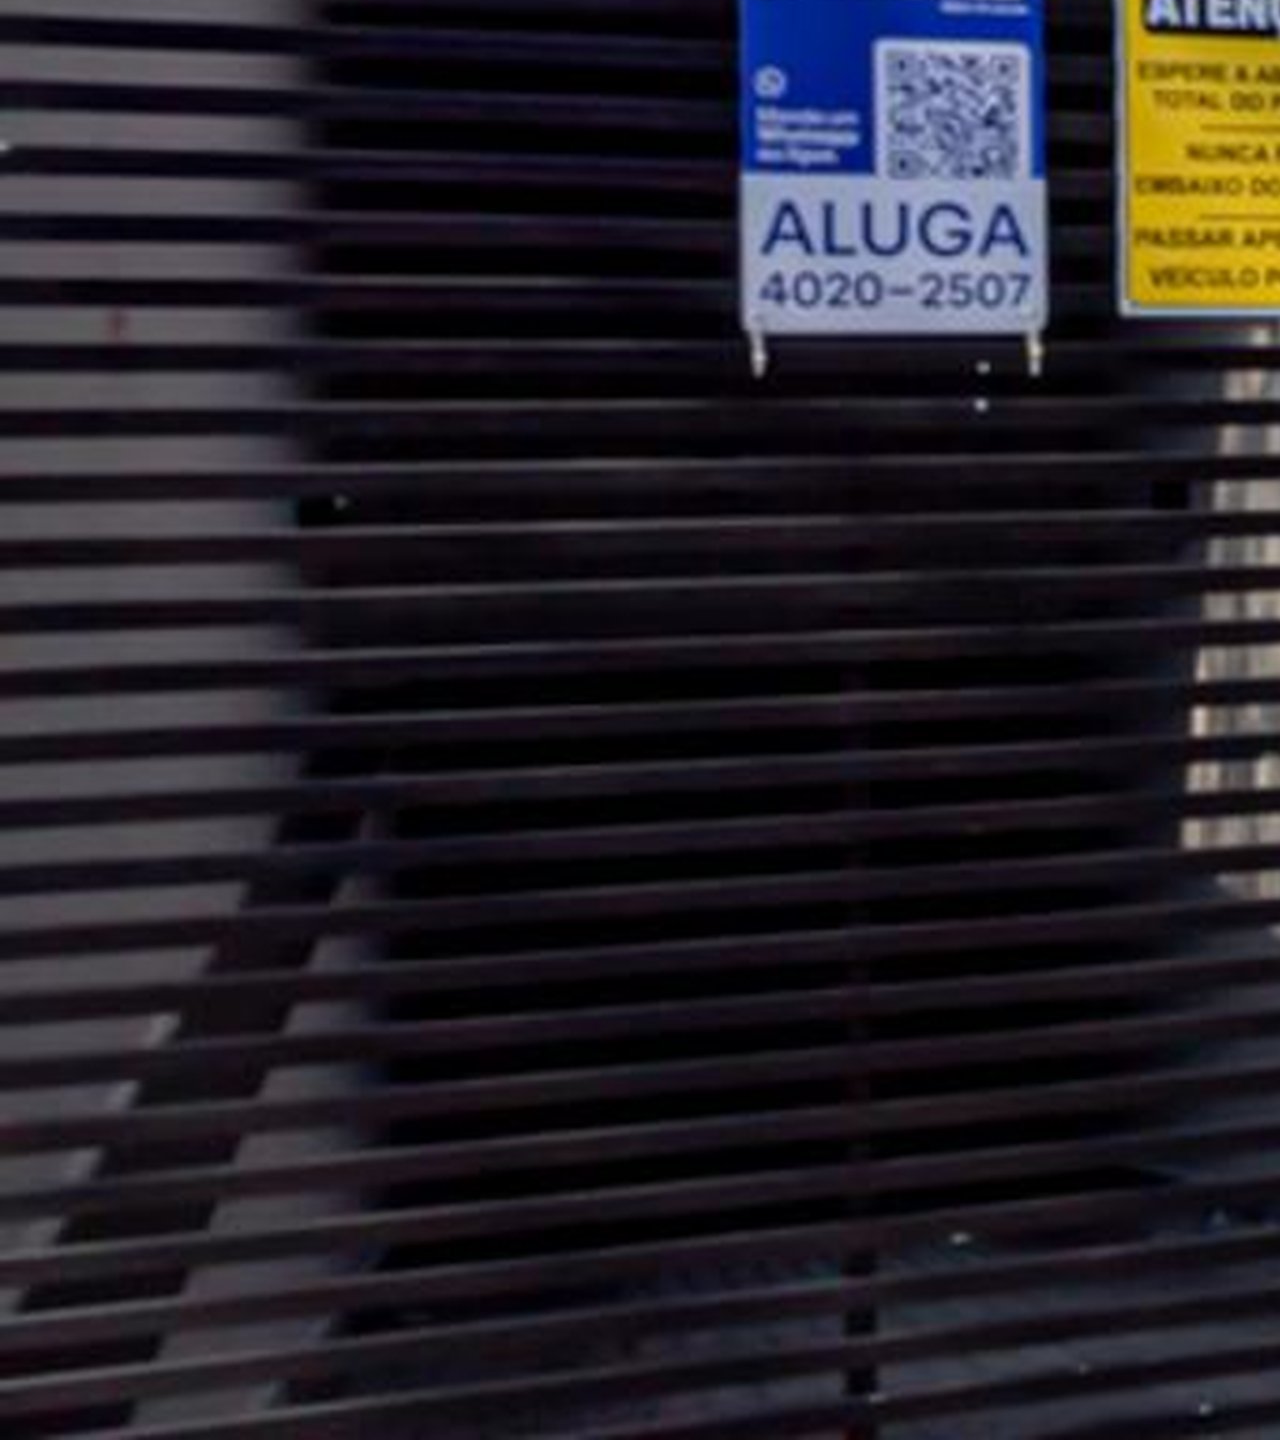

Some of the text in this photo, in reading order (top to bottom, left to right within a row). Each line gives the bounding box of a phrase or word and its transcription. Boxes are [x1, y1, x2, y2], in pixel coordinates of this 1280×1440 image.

[1138, 61, 1225, 83] ESPERE
[1153, 90, 1221, 110] TOTAL
[1230, 92, 1263, 111] DO
[1186, 143, 1269, 163] NUNCA
[1136, 176, 1245, 195] EMBAIXO
[761, 199, 1030, 258] ALUGA
[1136, 229, 1234, 248] PASSAR
[760, 270, 1032, 309] 4020-2507
